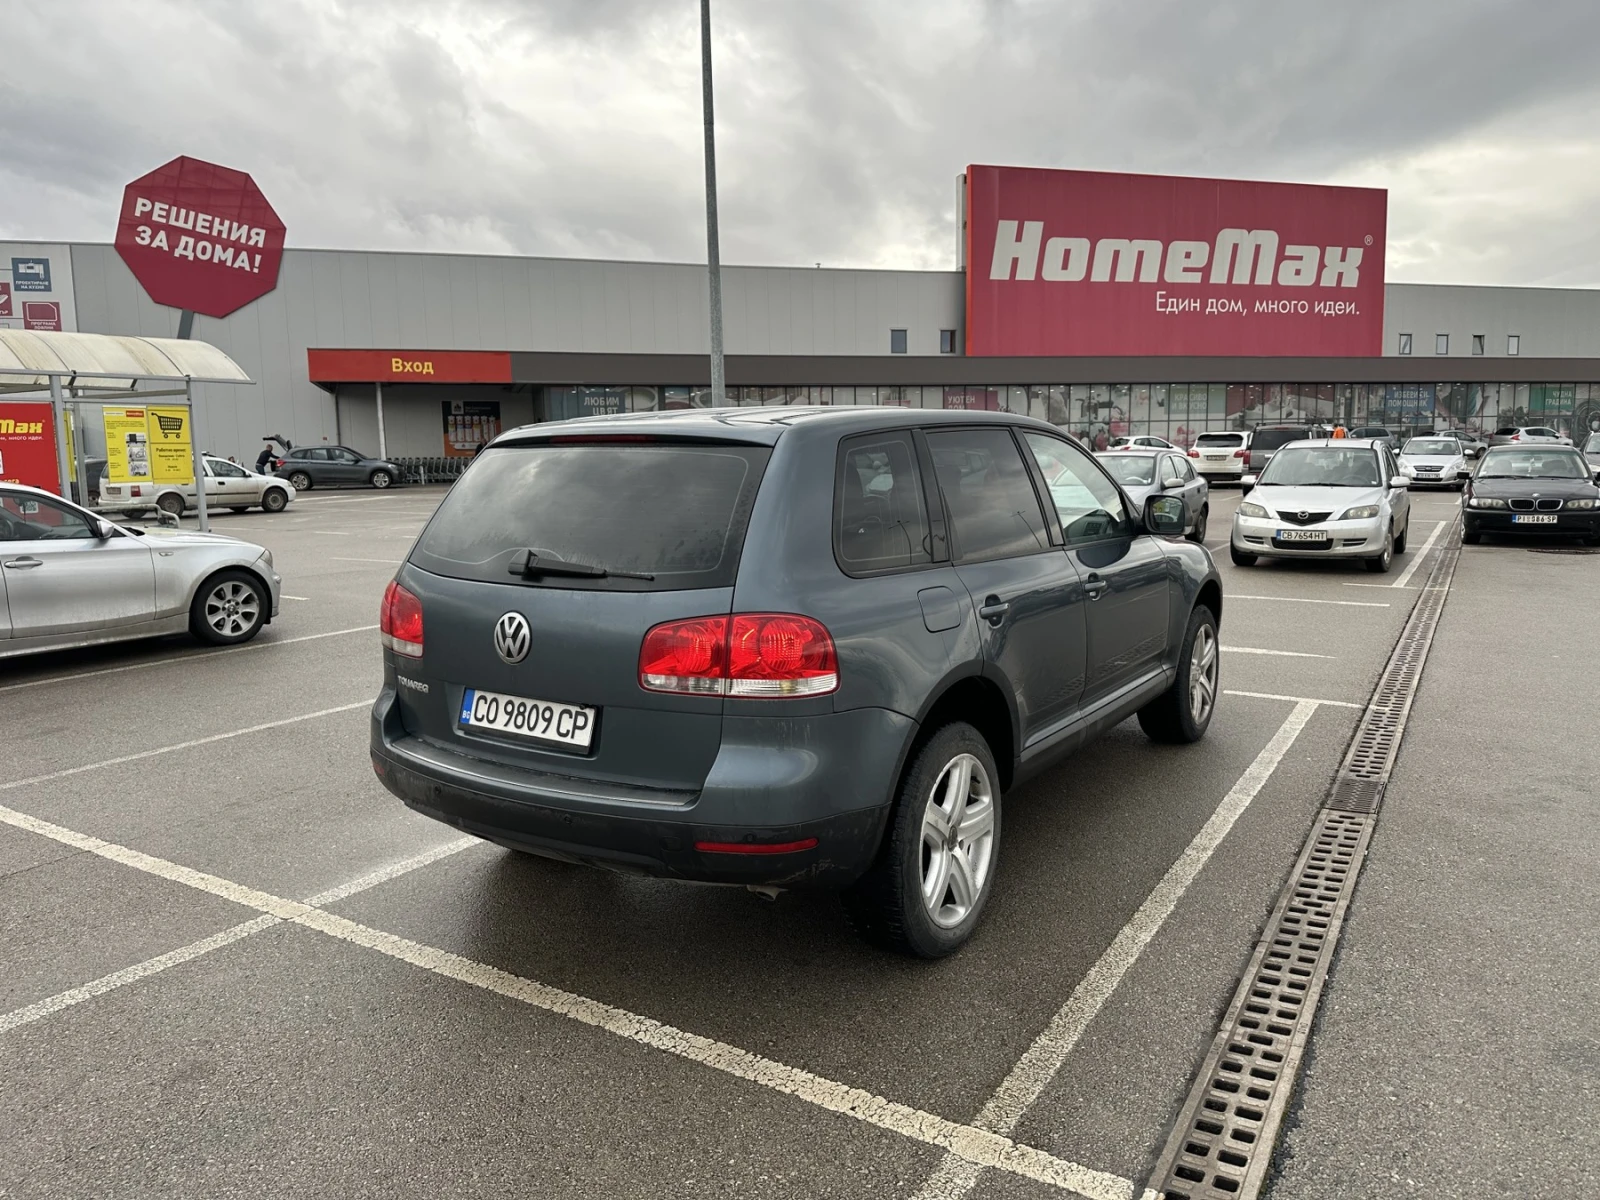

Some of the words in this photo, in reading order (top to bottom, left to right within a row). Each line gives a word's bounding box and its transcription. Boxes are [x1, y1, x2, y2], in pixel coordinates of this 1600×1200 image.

[134, 197, 266, 248] РЕШЕНИЯ
[135, 225, 169, 251] ЗА
[174, 235, 262, 273] ДОМА!
[989, 219, 1364, 288] HomeMax
[1156, 291, 1200, 314] Един
[1206, 298, 1247, 316] дом,
[1254, 300, 1309, 314] много
[1314, 301, 1360, 317] идеи.
[391, 357, 434, 375] Вход
[583, 397, 619, 406] ЛЮБИМ
[947, 395, 976, 404] УЮТЕН
[1174, 393, 1207, 401] КРАСИВО
[1545, 398, 1572, 406] ГРАДИНА
[1388, 399, 1428, 408] ПОМОЩНИК
[592, 407, 618, 416] ЦВЯТ
[0, 419, 43, 434] Max
[1282, 531, 1293, 540] CB
[1294, 531, 1313, 540] 7654
[1314, 531, 1326, 540] HT
[397, 675, 429, 694] TOUAREG
[462, 709, 471, 719] BG
[474, 694, 499, 725] CO
[503, 699, 554, 734] 9809
[556, 708, 589, 740] CP
